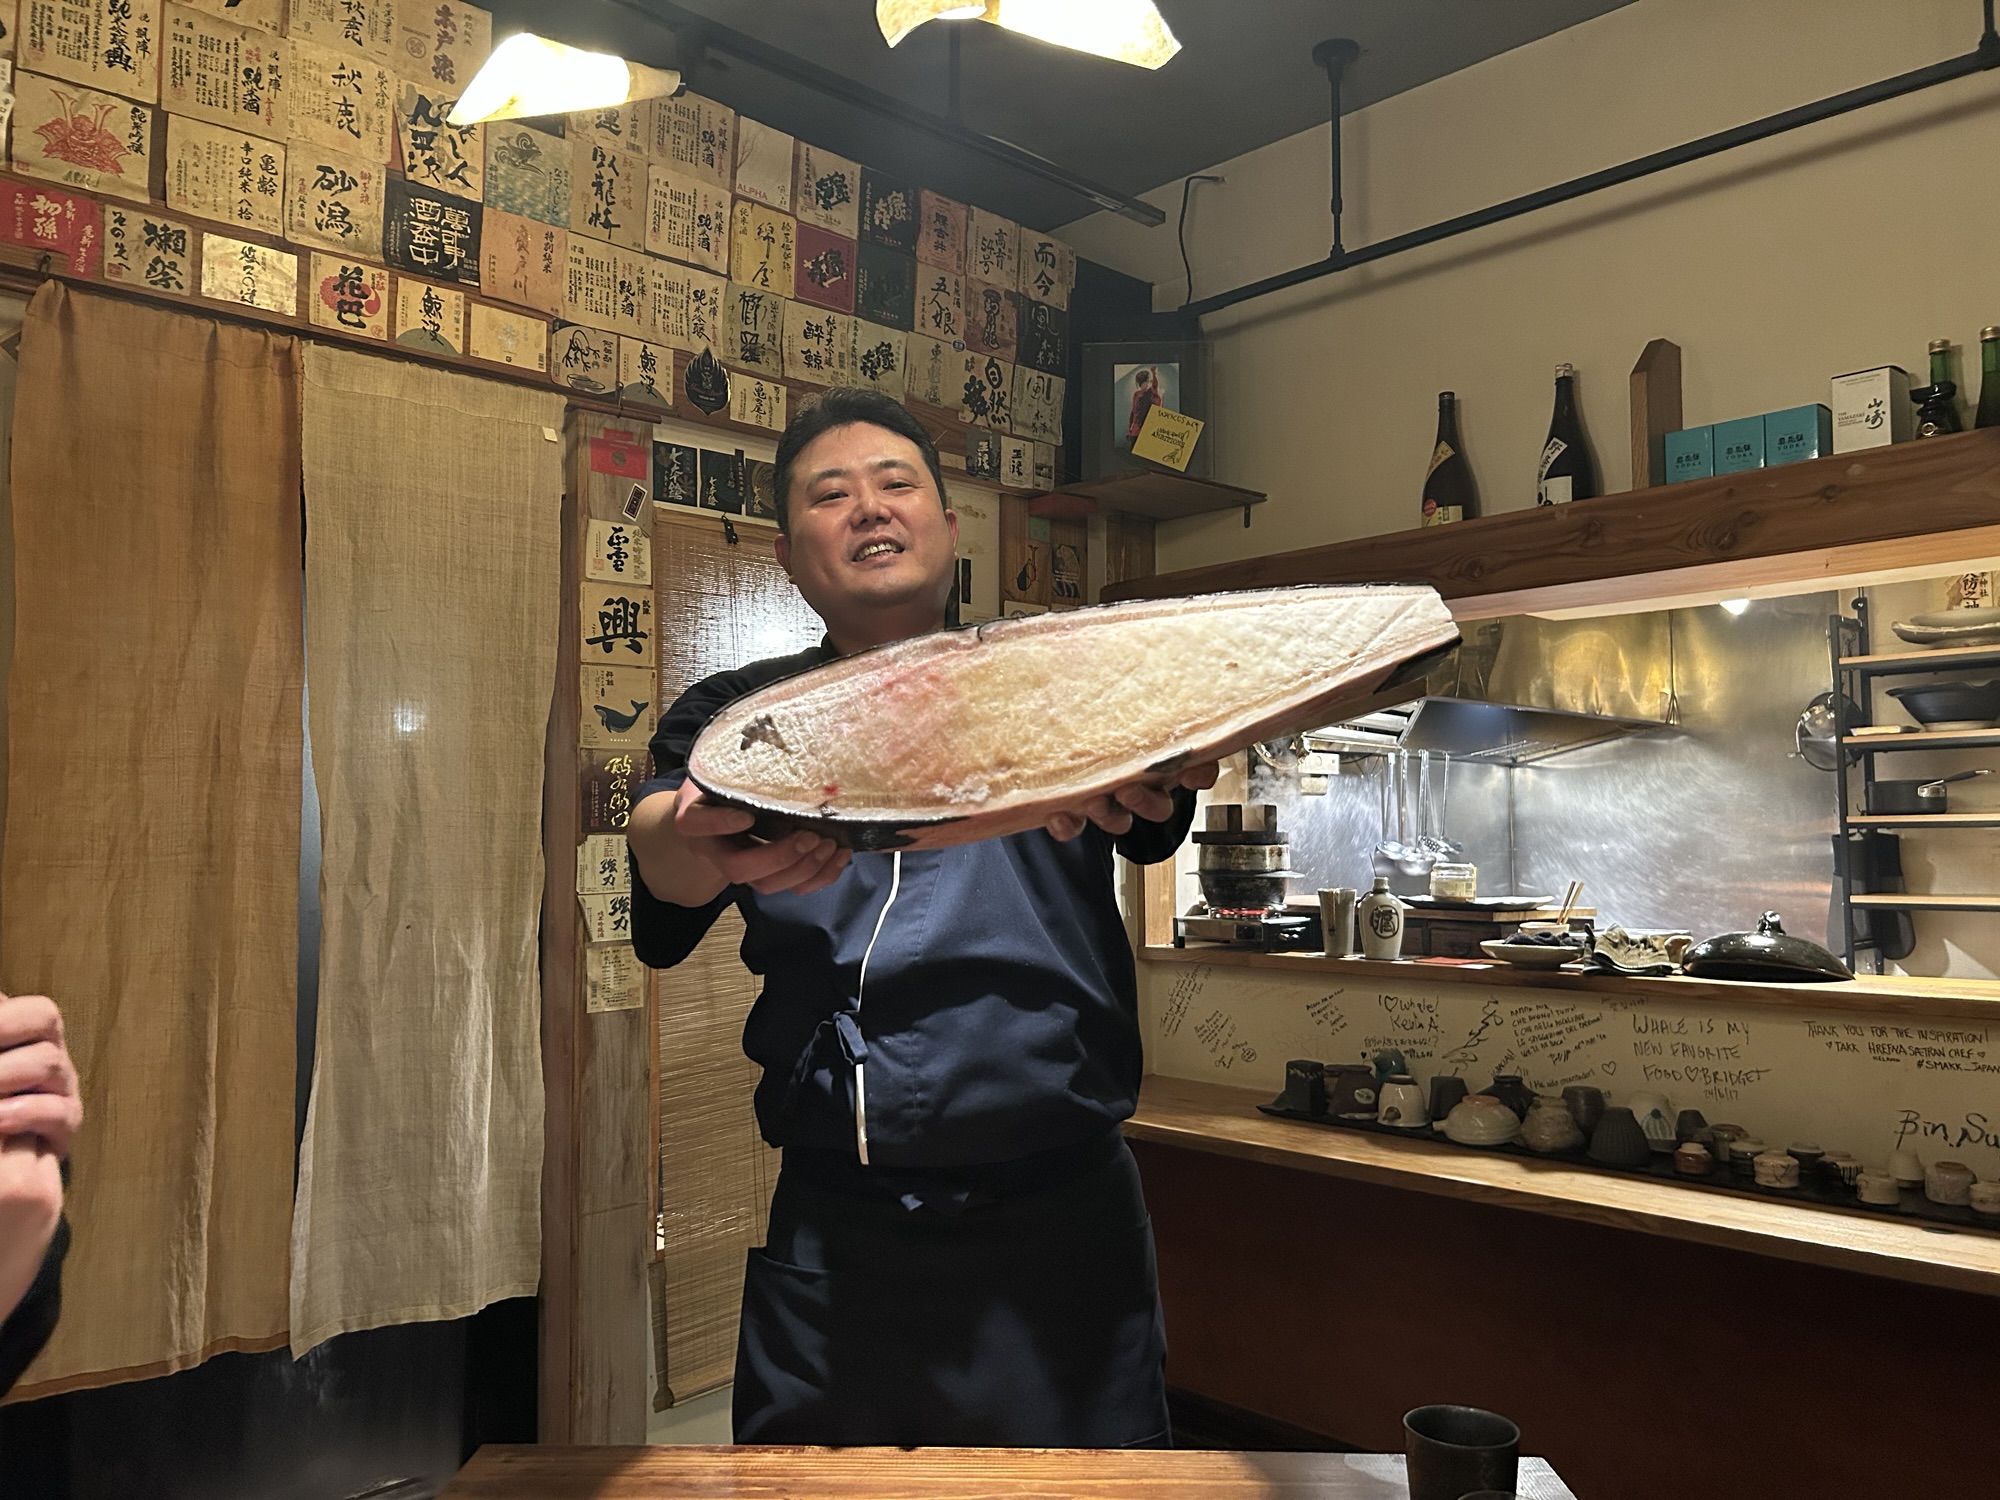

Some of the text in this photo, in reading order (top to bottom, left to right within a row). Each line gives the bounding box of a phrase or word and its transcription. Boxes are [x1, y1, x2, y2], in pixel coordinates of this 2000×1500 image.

[331, 62, 363, 139] 秋鹿
[127, 106, 148, 156] 純米吟醸
[237, 140, 255, 194] 辛口純米
[257, 153, 279, 198] 亀齢
[312, 164, 359, 239] 砂潟
[737, 182, 769, 201] ALPHA
[29, 193, 62, 240] 初孫
[697, 213, 713, 253] 純米酒
[110, 210, 132, 272] その先へ
[542, 230, 555, 274] 特別純米
[751, 221, 776, 288] 綿屋
[1032, 242, 1057, 298] 而今
[332, 264, 371, 329] 花巴
[618, 279, 636, 318] 純米酒
[927, 276, 957, 336] 五人娘
[800, 319, 825, 371] 酔鯨
[1725, 451, 1754, 461] VODKA
[1777, 441, 1806, 451] VODKA
[585, 596, 648, 656] 興
[599, 857, 618, 886] 強力
[608, 895, 631, 932] 強力
[1369, 904, 1401, 939] 酒
[1633, 1014, 1690, 1035] WHALE
[1803, 1020, 1839, 1038] THANK
[1843, 1023, 1865, 1037] YOU
[1870, 1025, 1889, 1038] FOR
[1633, 1040, 1663, 1057] NEW
[1642, 1063, 1772, 1086] FOOD BRIDGET
